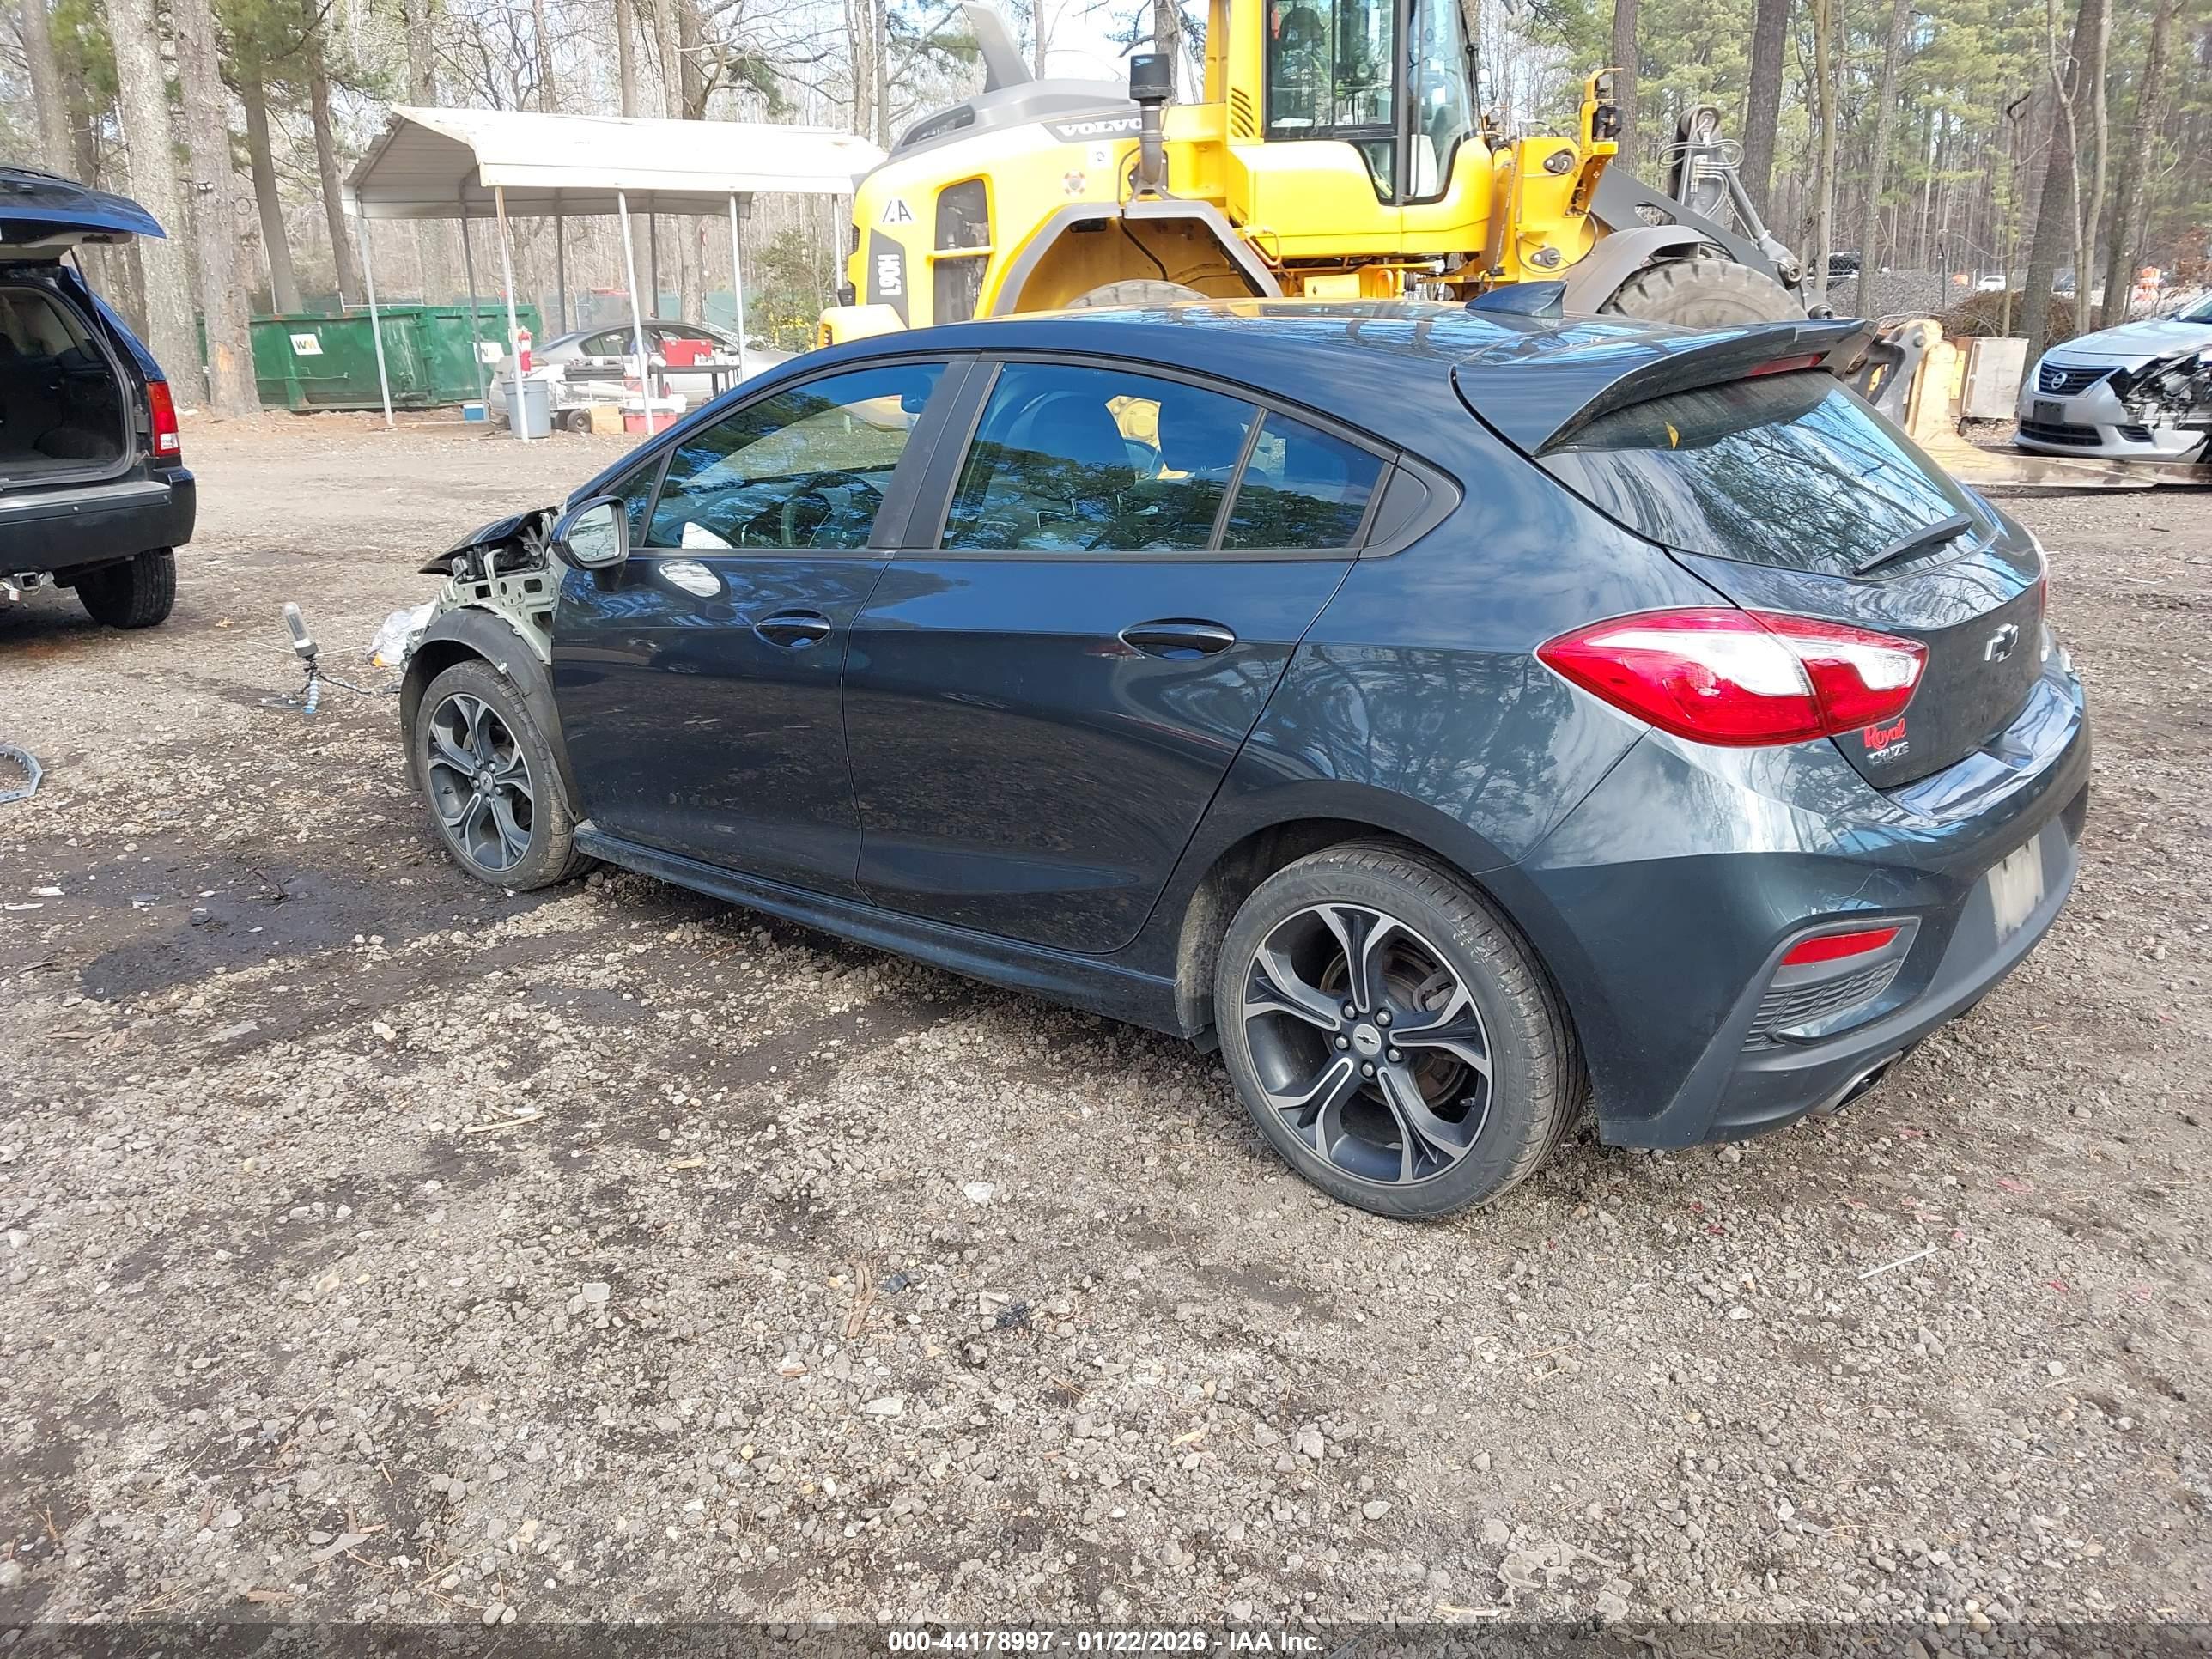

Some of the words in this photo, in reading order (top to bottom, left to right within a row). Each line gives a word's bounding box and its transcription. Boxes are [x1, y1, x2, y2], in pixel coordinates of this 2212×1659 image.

[1056, 118, 1142, 137] VOLVO
[877, 254, 902, 295] L90H
[295, 339, 317, 349] WM
[1864, 718, 1906, 750] Royal
